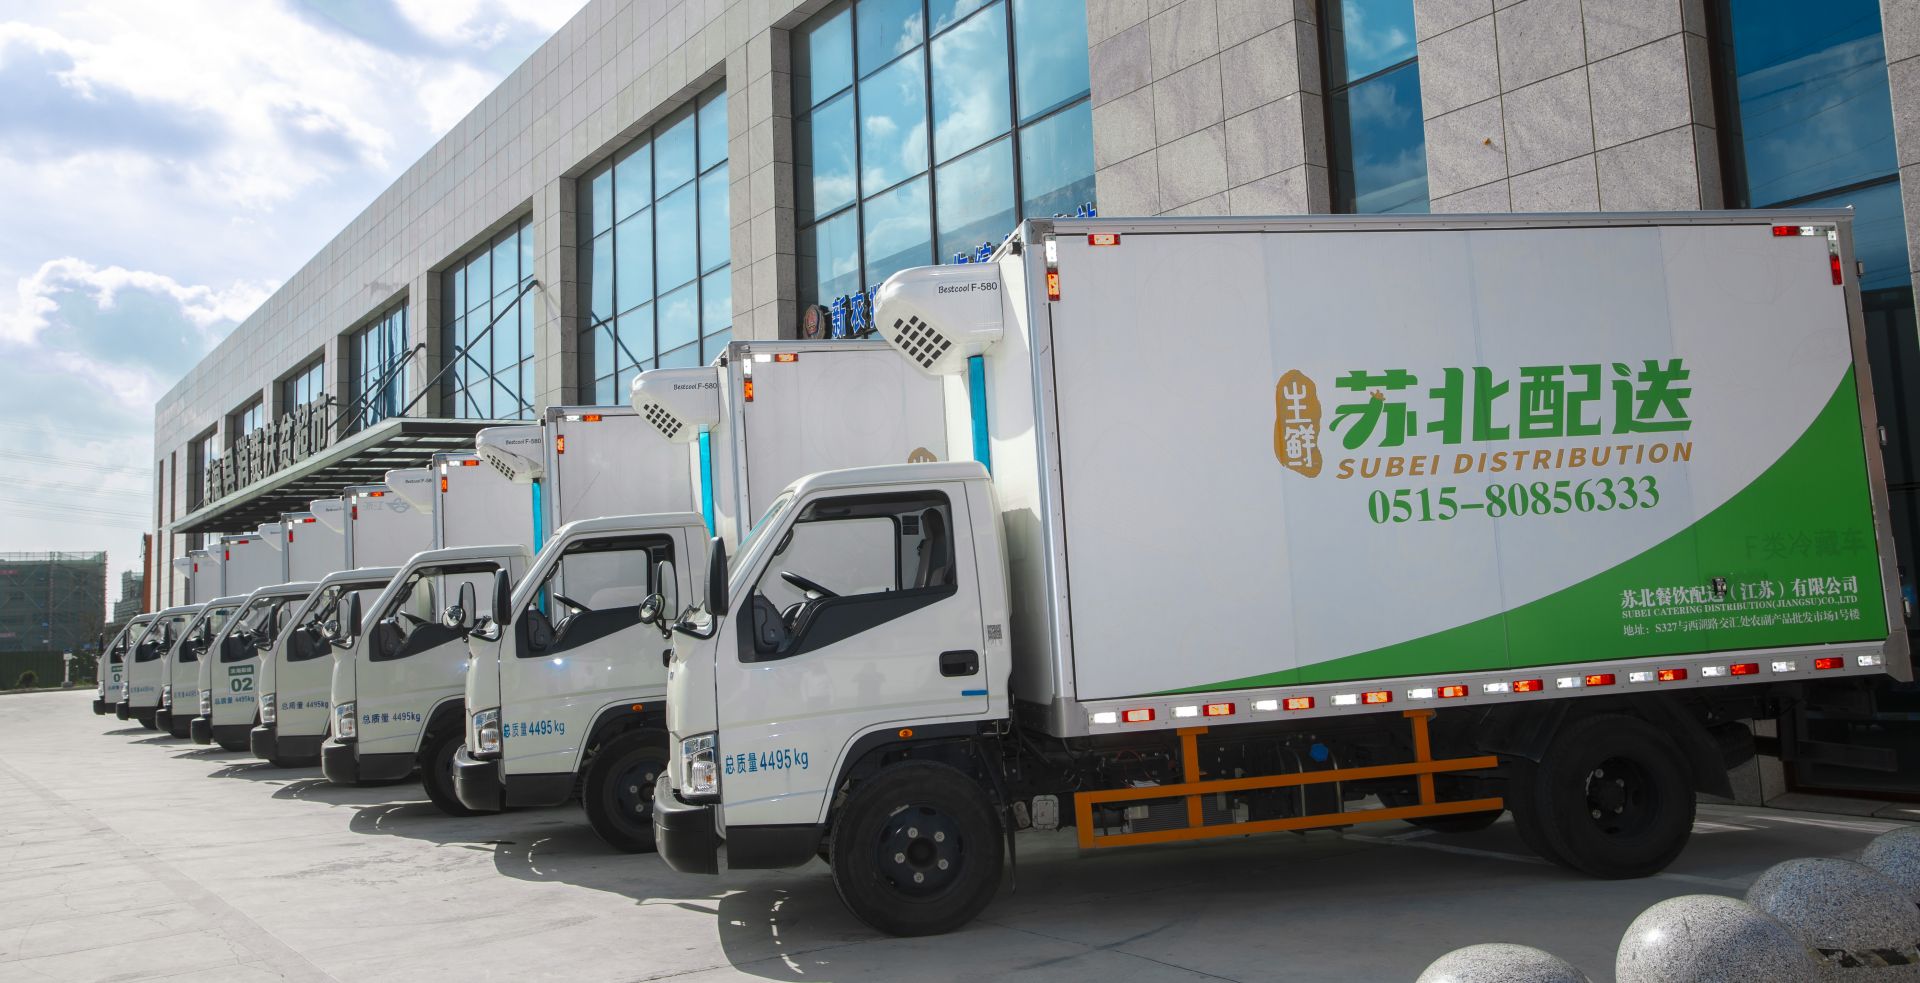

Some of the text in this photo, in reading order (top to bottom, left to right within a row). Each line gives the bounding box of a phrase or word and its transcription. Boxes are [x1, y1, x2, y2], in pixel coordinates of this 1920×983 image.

[938, 281, 998, 294] Bestcool F-580
[1329, 358, 1693, 450] 苏北配送
[1283, 381, 1316, 468] 生鲜
[1335, 441, 1694, 480] SUBEI DISTRIBUTION
[1368, 475, 1661, 524] 0515-80856333
[1622, 608, 1651, 619] SUBEI
[1653, 604, 1703, 617] CATERING
[231, 677, 253, 693] 02
